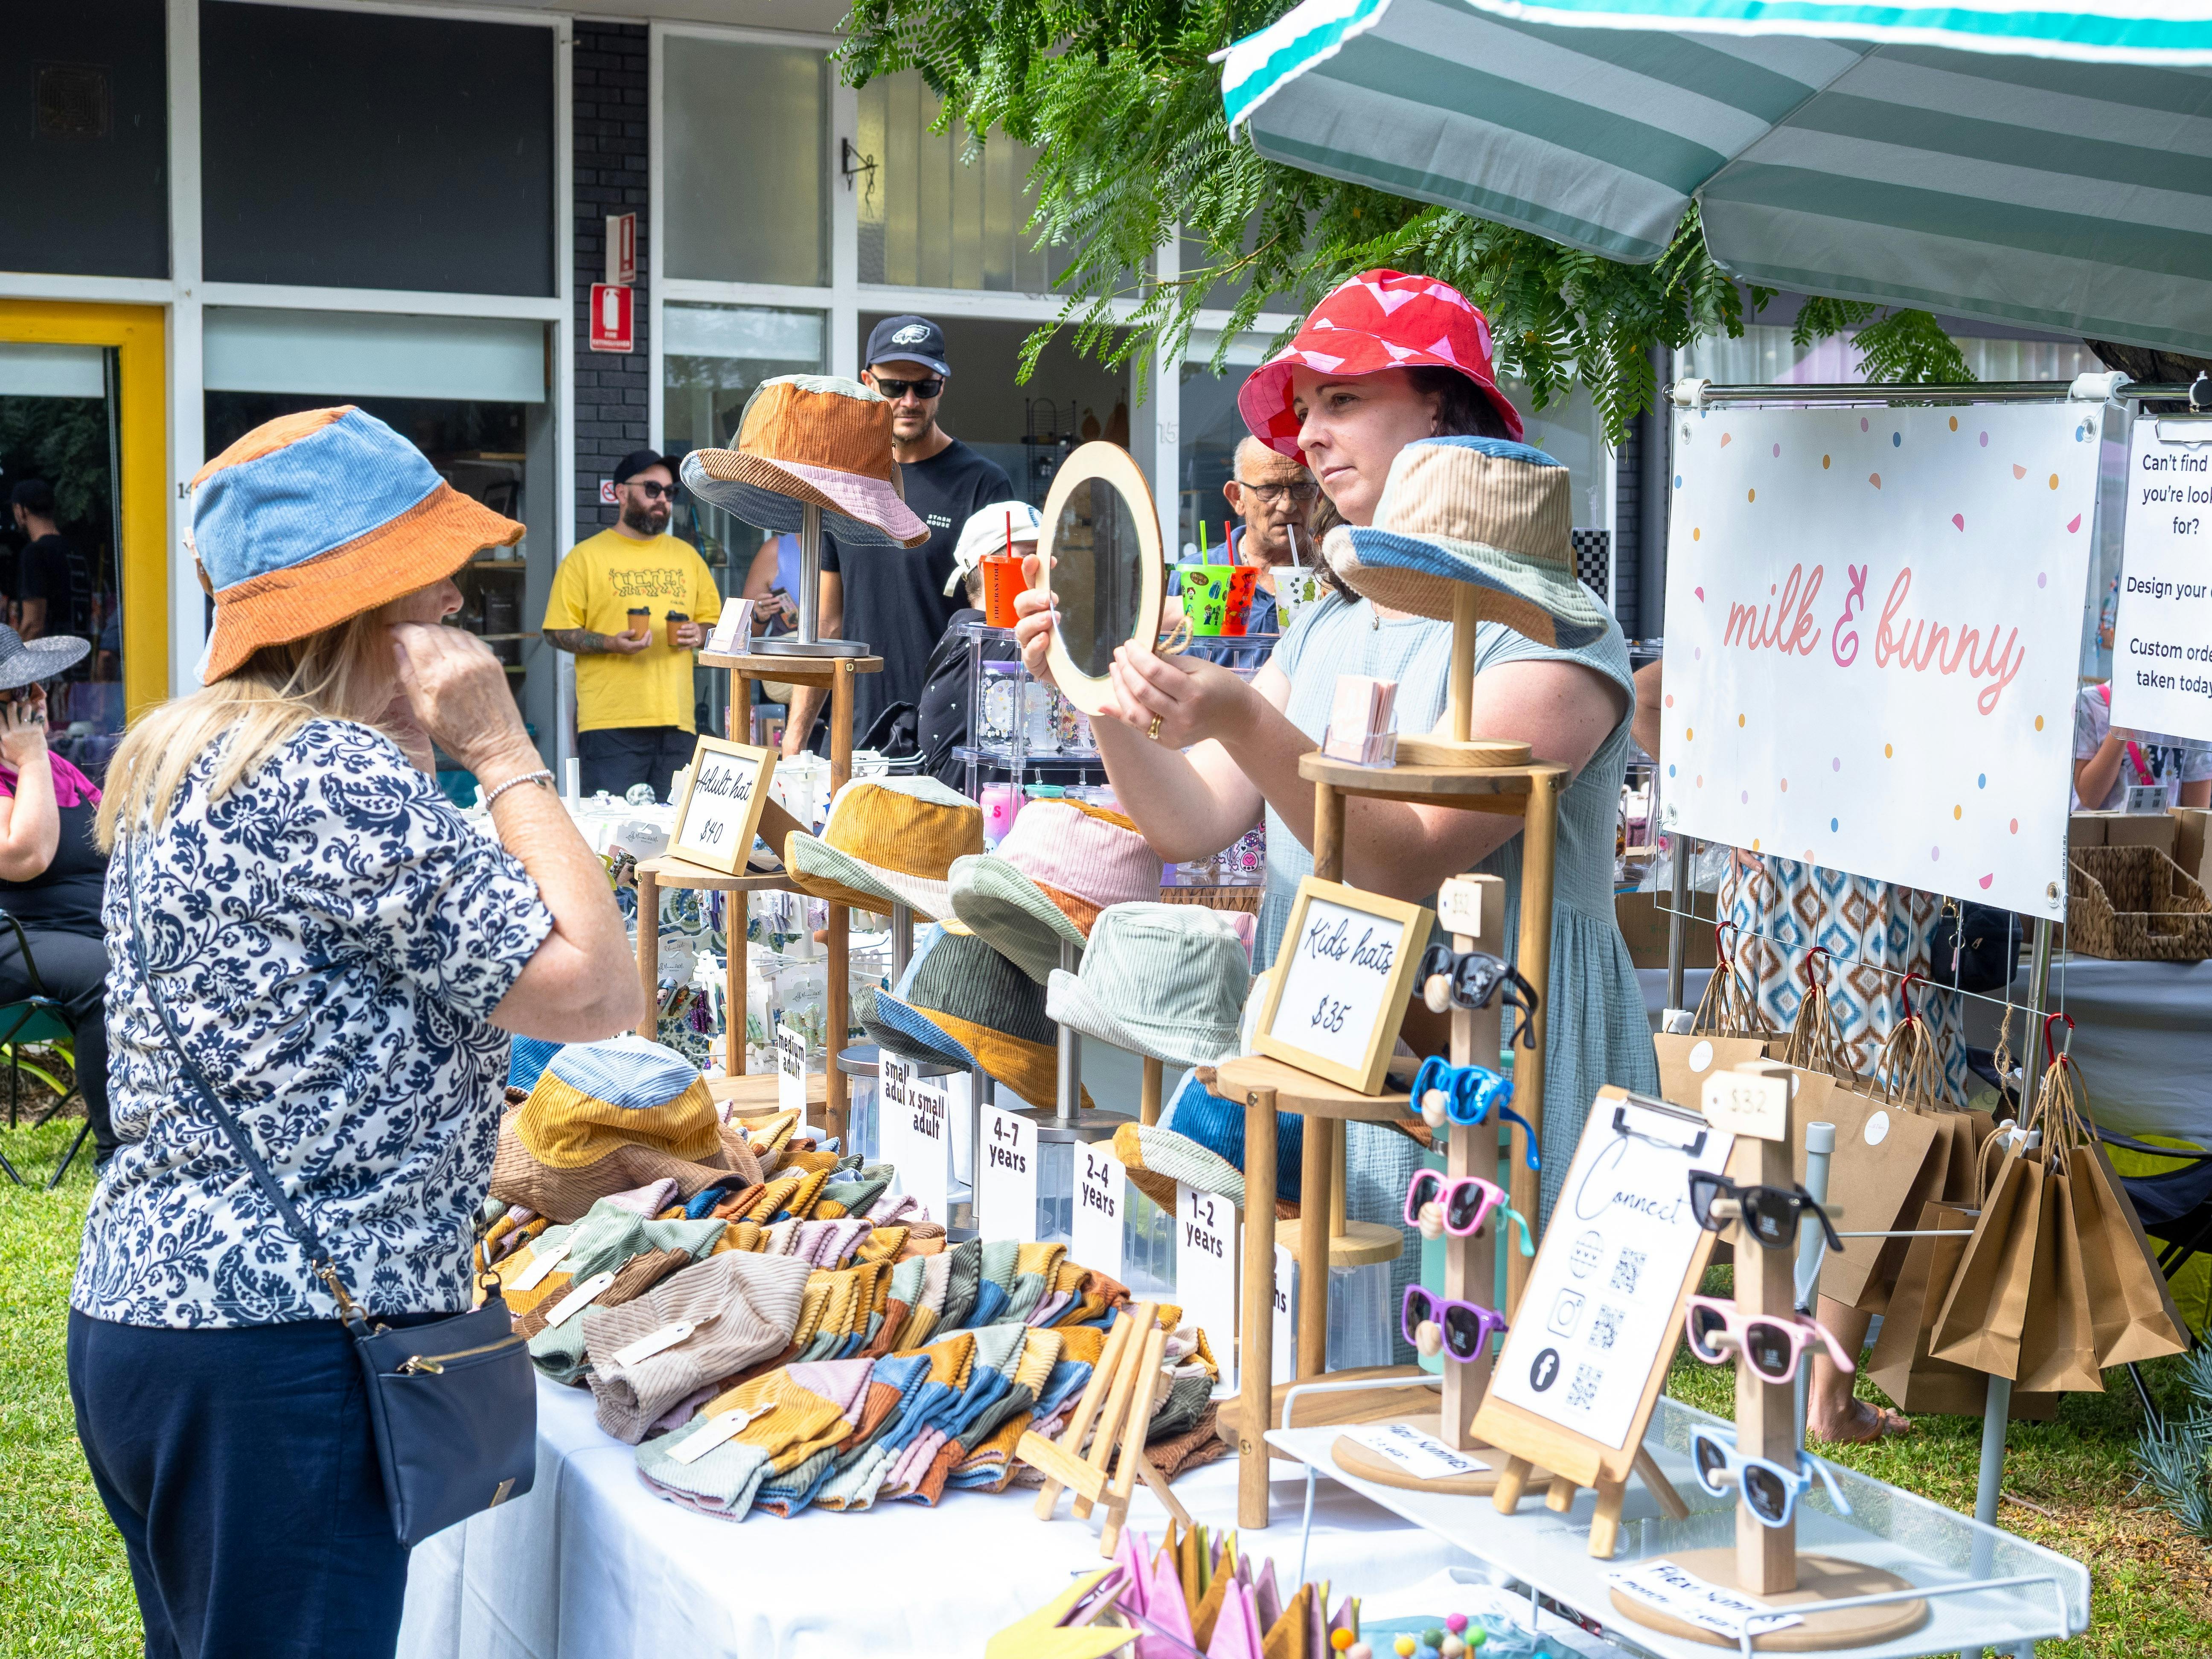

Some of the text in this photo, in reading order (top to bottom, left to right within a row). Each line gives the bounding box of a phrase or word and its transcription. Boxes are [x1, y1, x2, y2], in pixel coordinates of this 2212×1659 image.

[1157, 422, 1178, 444] 15
[2142, 454, 2208, 472] Can't find
[2142, 485, 2183, 505] you're
[926, 519, 950, 529] HOUSE
[928, 514, 951, 523] STASH
[2173, 517, 2200, 536] for?
[2127, 576, 2207, 600] Design your
[1723, 563, 1823, 656] milk
[1875, 567, 2025, 716] bunny
[2130, 637, 2183, 659] Custom
[2137, 670, 2175, 689] taken
[696, 765, 732, 796] Adult
[700, 818, 723, 844] $40
[1304, 917, 1394, 975] Kids hats
[1312, 993, 1352, 1033] $35
[778, 1032, 805, 1063] medium
[783, 1056, 801, 1080] adult
[917, 1093, 944, 1119] small
[1731, 1088, 1767, 1115] $32
[913, 1111, 940, 1140] adult
[993, 1117, 1020, 1147] 4-7
[989, 1144, 1026, 1174] years
[1087, 1154, 1109, 1188] 2-4
[1575, 1136, 1692, 1224] Connect
[1082, 1182, 1115, 1218] years
[1191, 1193, 1214, 1228] 1-2
[1186, 1221, 1223, 1259] years
